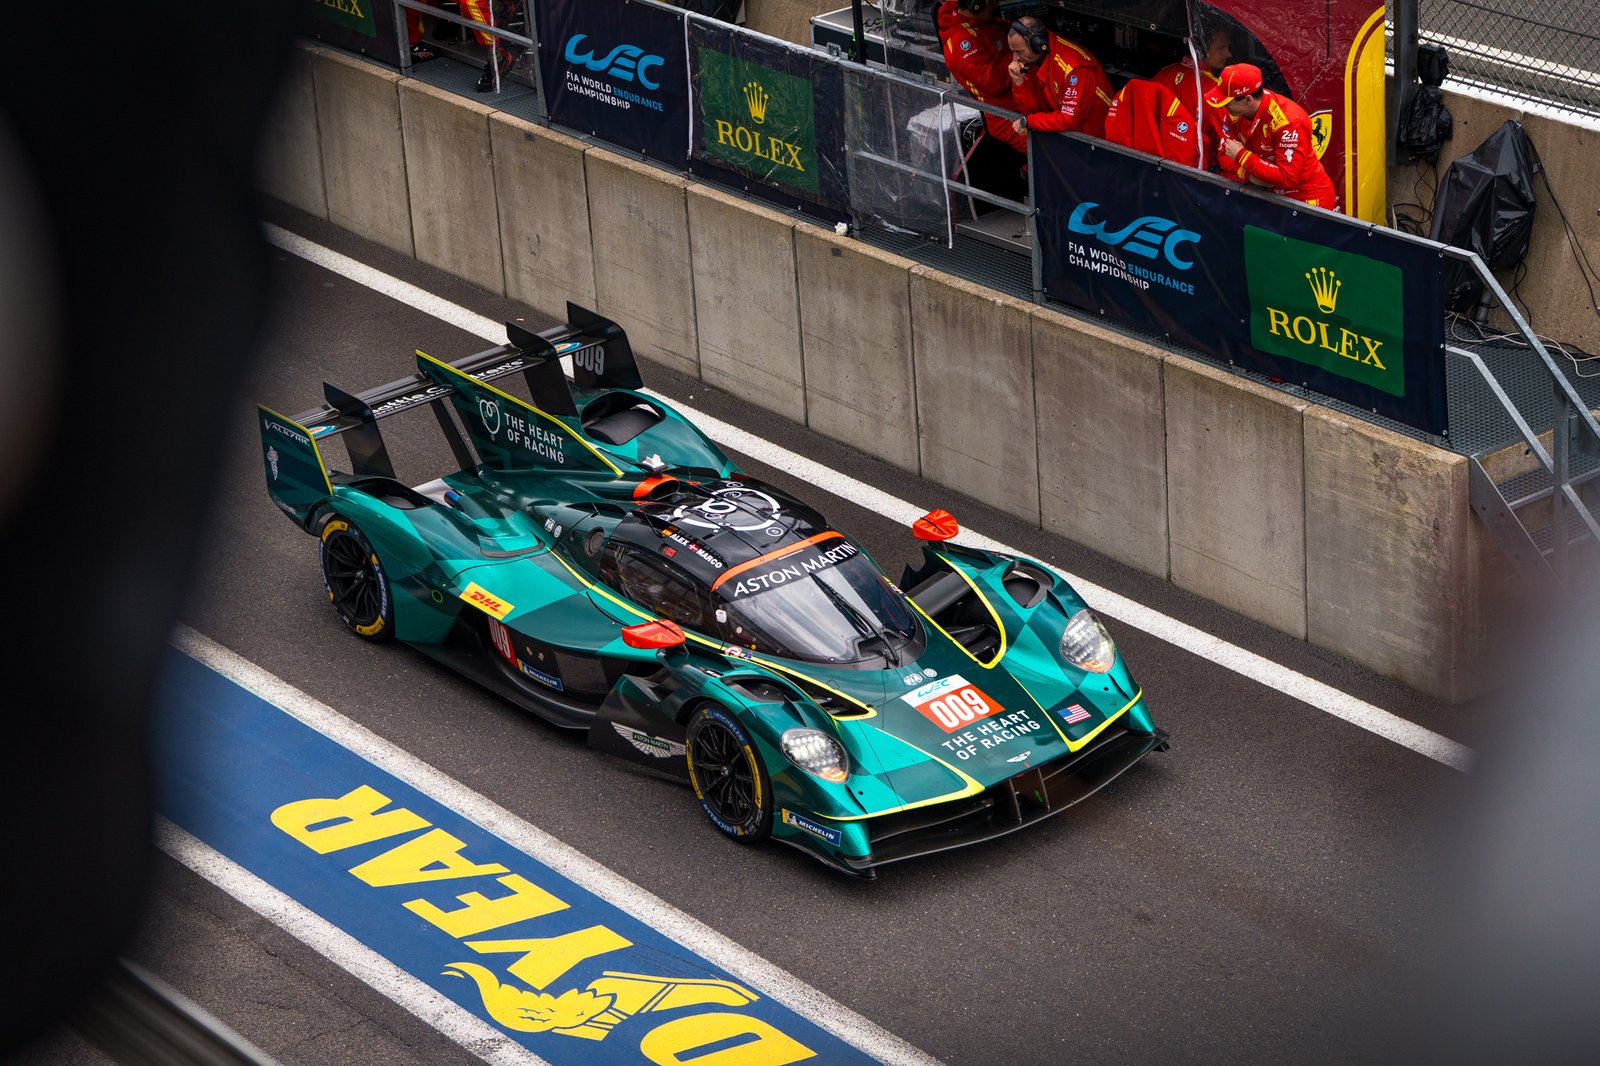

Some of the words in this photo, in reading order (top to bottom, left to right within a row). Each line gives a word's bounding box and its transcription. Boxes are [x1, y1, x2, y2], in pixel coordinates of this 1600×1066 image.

[565, 34, 664, 90] WEC
[566, 71, 580, 83] FIA
[581, 75, 611, 93] WORLD
[613, 87, 664, 112] ENDURANCE
[567, 82, 631, 110] CHAMPIONSHIP
[716, 119, 805, 172] ROLEX
[1068, 202, 1201, 270] WEC
[1069, 242, 1085, 256] FIA
[1090, 248, 1126, 270] WORLD
[1128, 264, 1194, 295] ENDURANCE
[1069, 254, 1150, 290] CHAMPIONSHIP
[1267, 307, 1386, 370] ROLEX
[504, 412, 525, 432] THE
[529, 423, 563, 449] HEART
[507, 429, 520, 444] OF
[524, 436, 564, 464] RACING
[670, 533, 690, 546] ALEX
[696, 548, 723, 569] MARCO
[734, 565, 801, 597] ASTON
[801, 541, 857, 573] MARTIN
[470, 591, 501, 612] DHL
[929, 688, 990, 728] 009
[941, 731, 977, 751] THE
[977, 709, 1020, 736] HEART
[956, 745, 977, 760] OF
[980, 720, 1041, 749] RACING
[799, 820, 835, 840] MICHELIN
